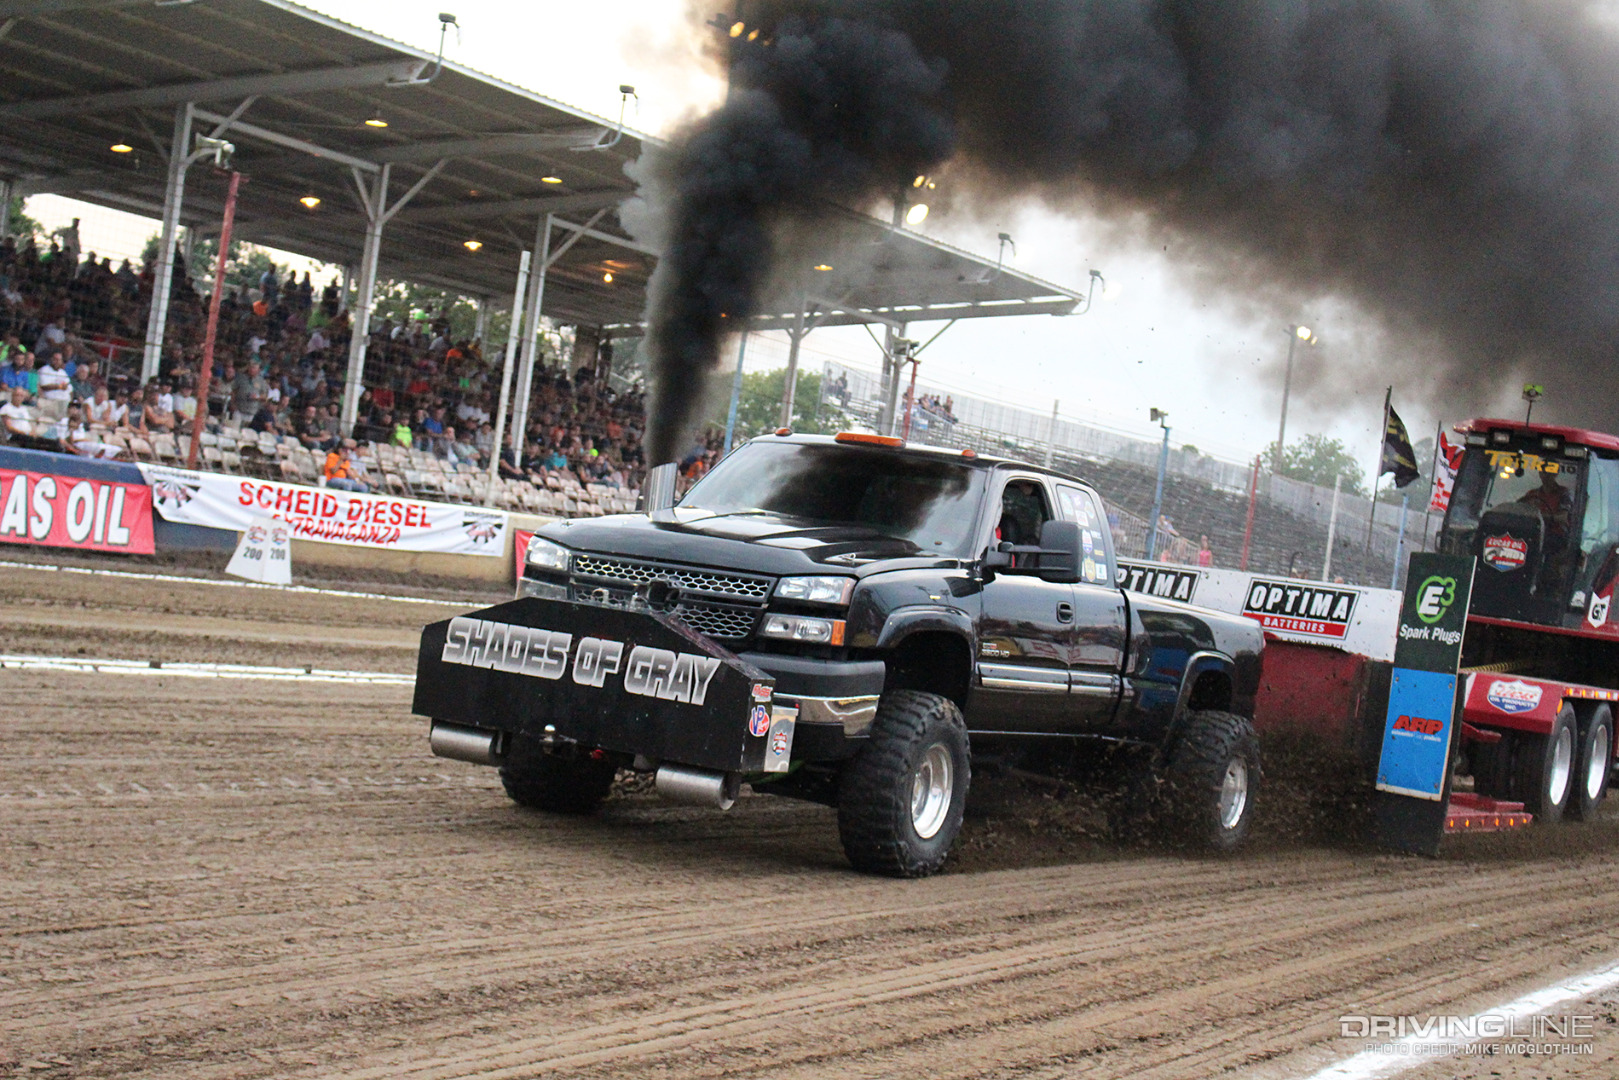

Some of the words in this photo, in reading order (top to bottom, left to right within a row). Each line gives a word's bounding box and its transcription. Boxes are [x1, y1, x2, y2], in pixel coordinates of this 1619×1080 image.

[1484, 450, 1559, 474] Tonka
[0, 474, 57, 542] AS
[66, 480, 130, 546] OIL
[237, 481, 339, 518] SCHEID
[346, 498, 432, 529] DIESEL
[243, 546, 263, 561] 200
[1115, 567, 1191, 600] PTIMA
[1249, 585, 1350, 620] OPTIMA
[1263, 616, 1326, 633] BATTERIES
[1399, 623, 1431, 640] Spark
[1431, 626, 1461, 646] Plugs
[441, 616, 573, 681] SHADES
[572, 636, 625, 688] OF
[624, 645, 722, 706] GRAY
[1392, 714, 1444, 735] ARP
